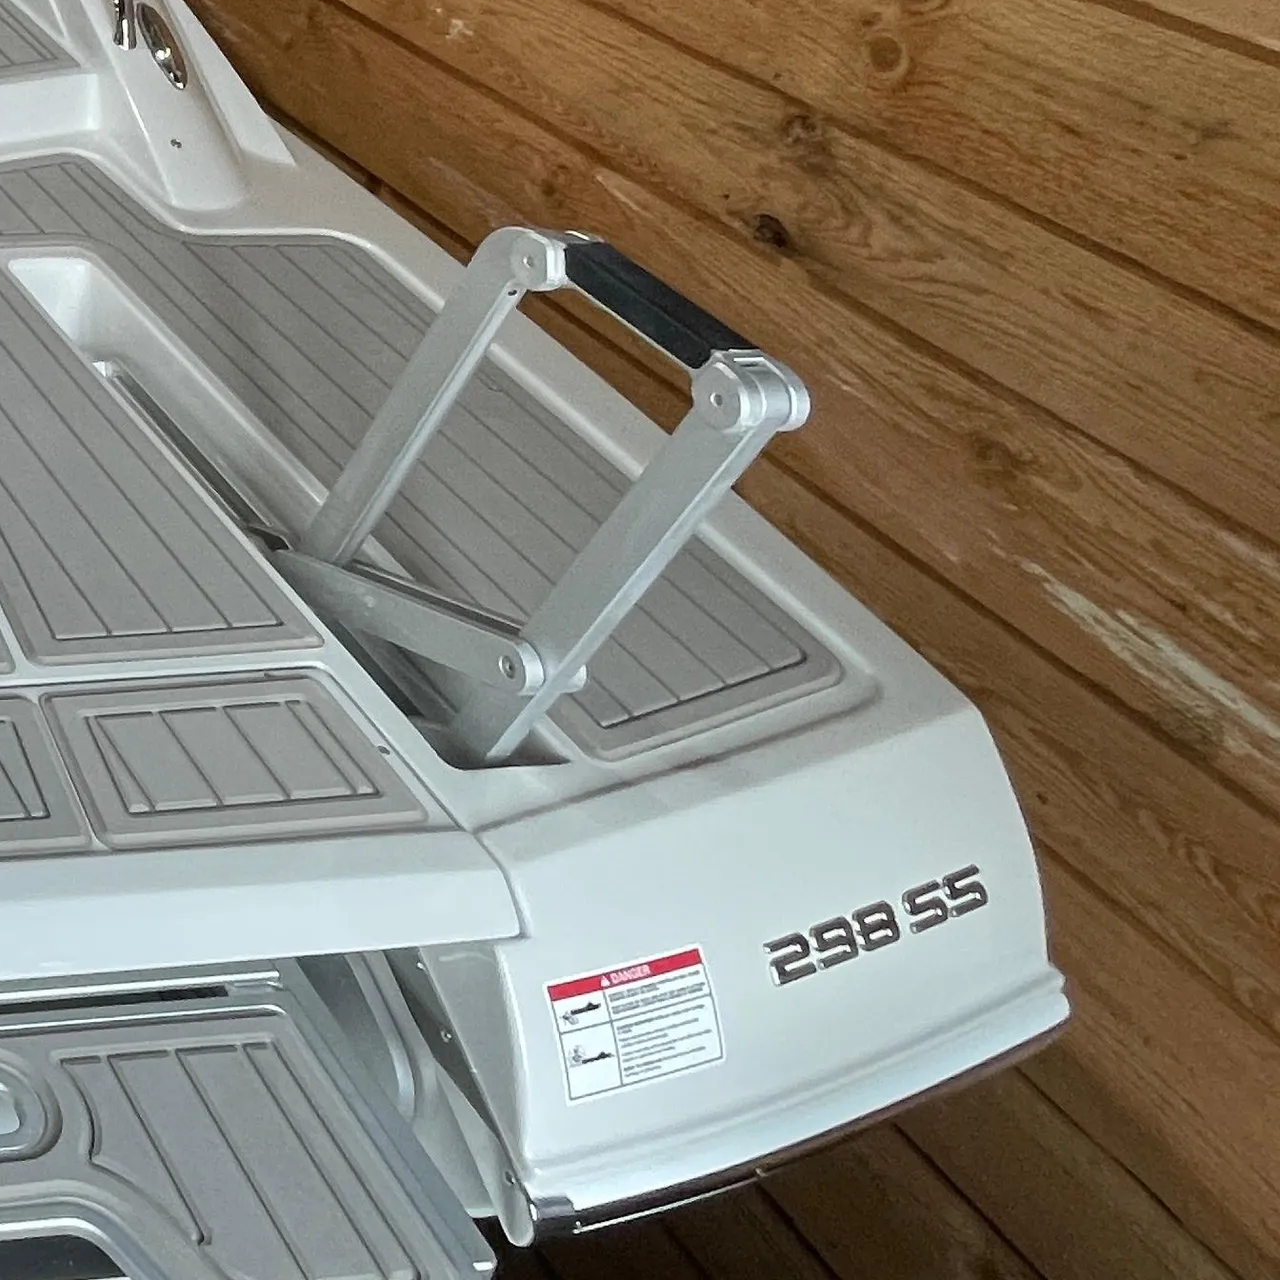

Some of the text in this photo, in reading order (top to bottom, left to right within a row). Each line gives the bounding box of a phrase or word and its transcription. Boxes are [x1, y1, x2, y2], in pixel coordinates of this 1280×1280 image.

[762, 863, 989, 988] 298 SS
[610, 964, 652, 984] DANGER
